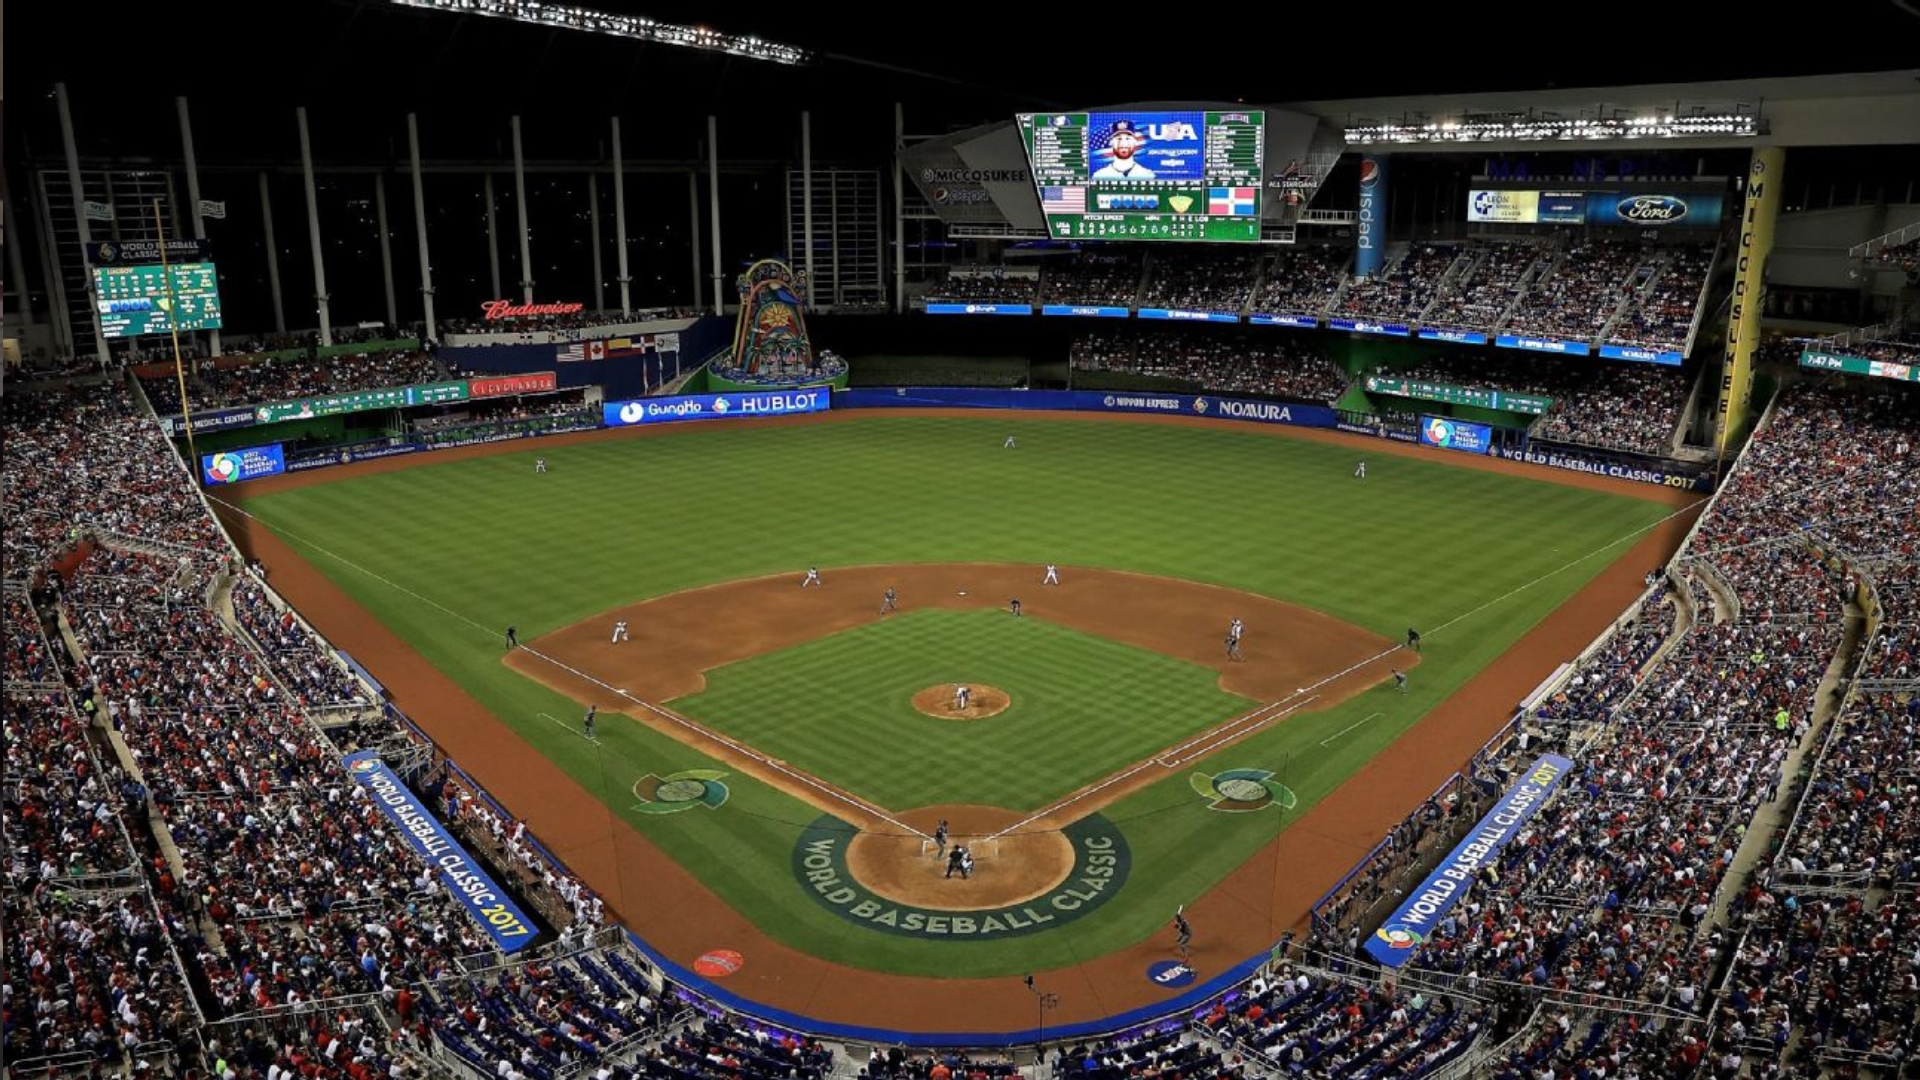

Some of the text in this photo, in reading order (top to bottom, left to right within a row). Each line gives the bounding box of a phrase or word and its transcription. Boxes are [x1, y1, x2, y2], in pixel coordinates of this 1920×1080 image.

[937, 169, 1026, 181] MICCOSUKEE
[1628, 200, 1673, 219] Ford
[1358, 193, 1374, 249] pepsi
[121, 242, 154, 251] WORLD
[121, 250, 160, 259] CLASSIC
[481, 299, 583, 320] Budweiser
[1807, 355, 1843, 368] 7:47 PM
[648, 393, 817, 416] GungHo HUBLOT
[1117, 397, 1180, 410] NIPPON EXPRESS
[1219, 401, 1292, 421] NOMURA
[224, 412, 254, 425] CENTERS
[243, 455, 267, 464] WORLD
[245, 460, 277, 469] BASEBALL
[1503, 449, 1696, 490] WORLD BASEBALL CLASSIC 2017
[1401, 762, 1560, 925] WORLD BASEBALL CLASSIC 2017
[367, 771, 529, 937] WORLD BASEBALL CLASSIC 2017
[803, 836, 1116, 935] WORLD BASEBALL CLASSIC
